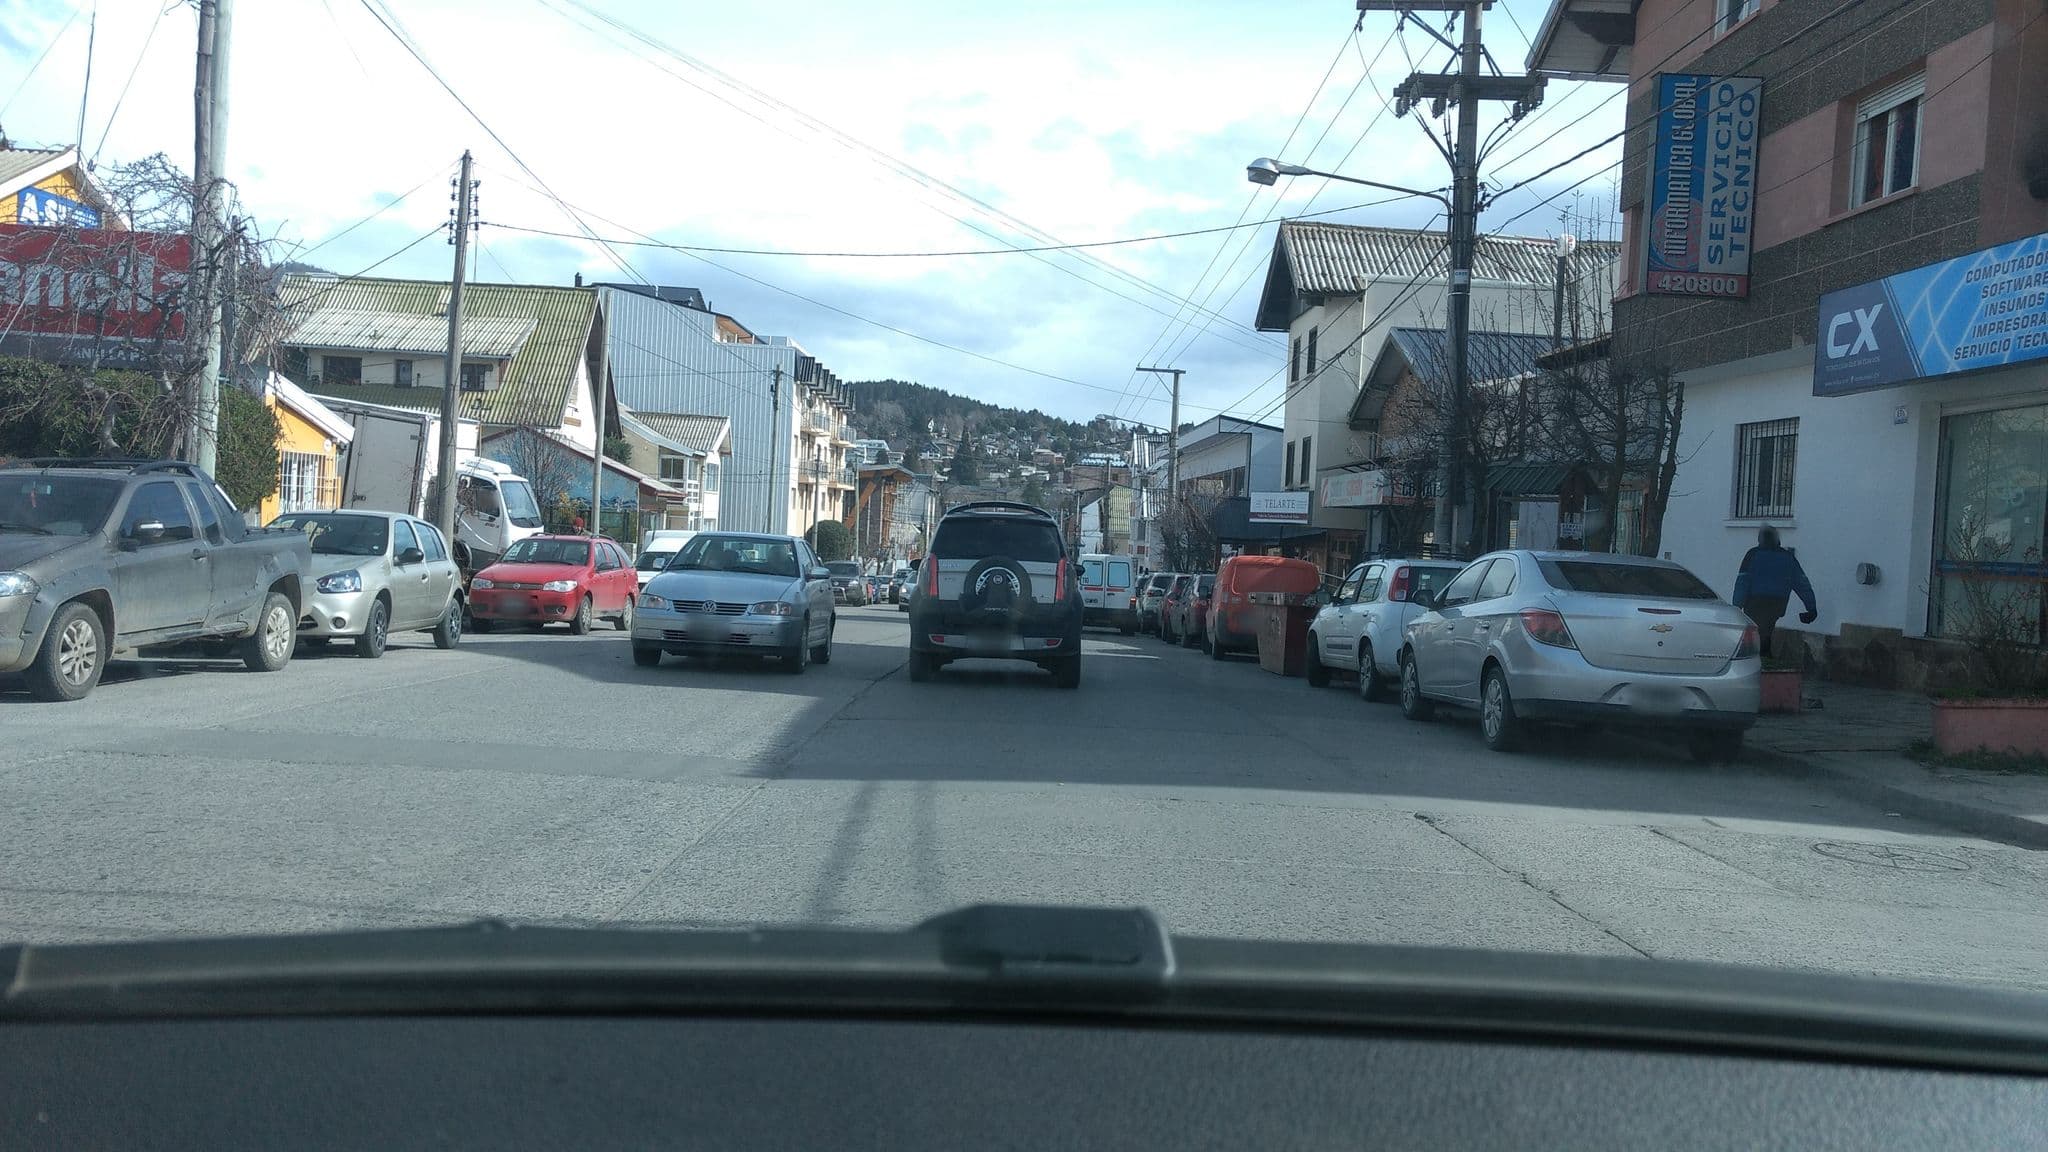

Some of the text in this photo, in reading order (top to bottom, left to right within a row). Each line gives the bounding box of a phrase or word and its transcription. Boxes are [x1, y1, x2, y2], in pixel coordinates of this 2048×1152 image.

[1664, 77, 1698, 256] INFORMATICA GLOBAL
[1708, 83, 1734, 265] SERVICIO
[1729, 93, 1755, 258] TECNICO
[1657, 274, 1738, 294] 420800
[1984, 292, 2045, 317] INSUMOS
[1827, 304, 1883, 359] CX
[1954, 338, 2011, 360] SERVICIO
[1264, 499, 1296, 509] TELARTE
